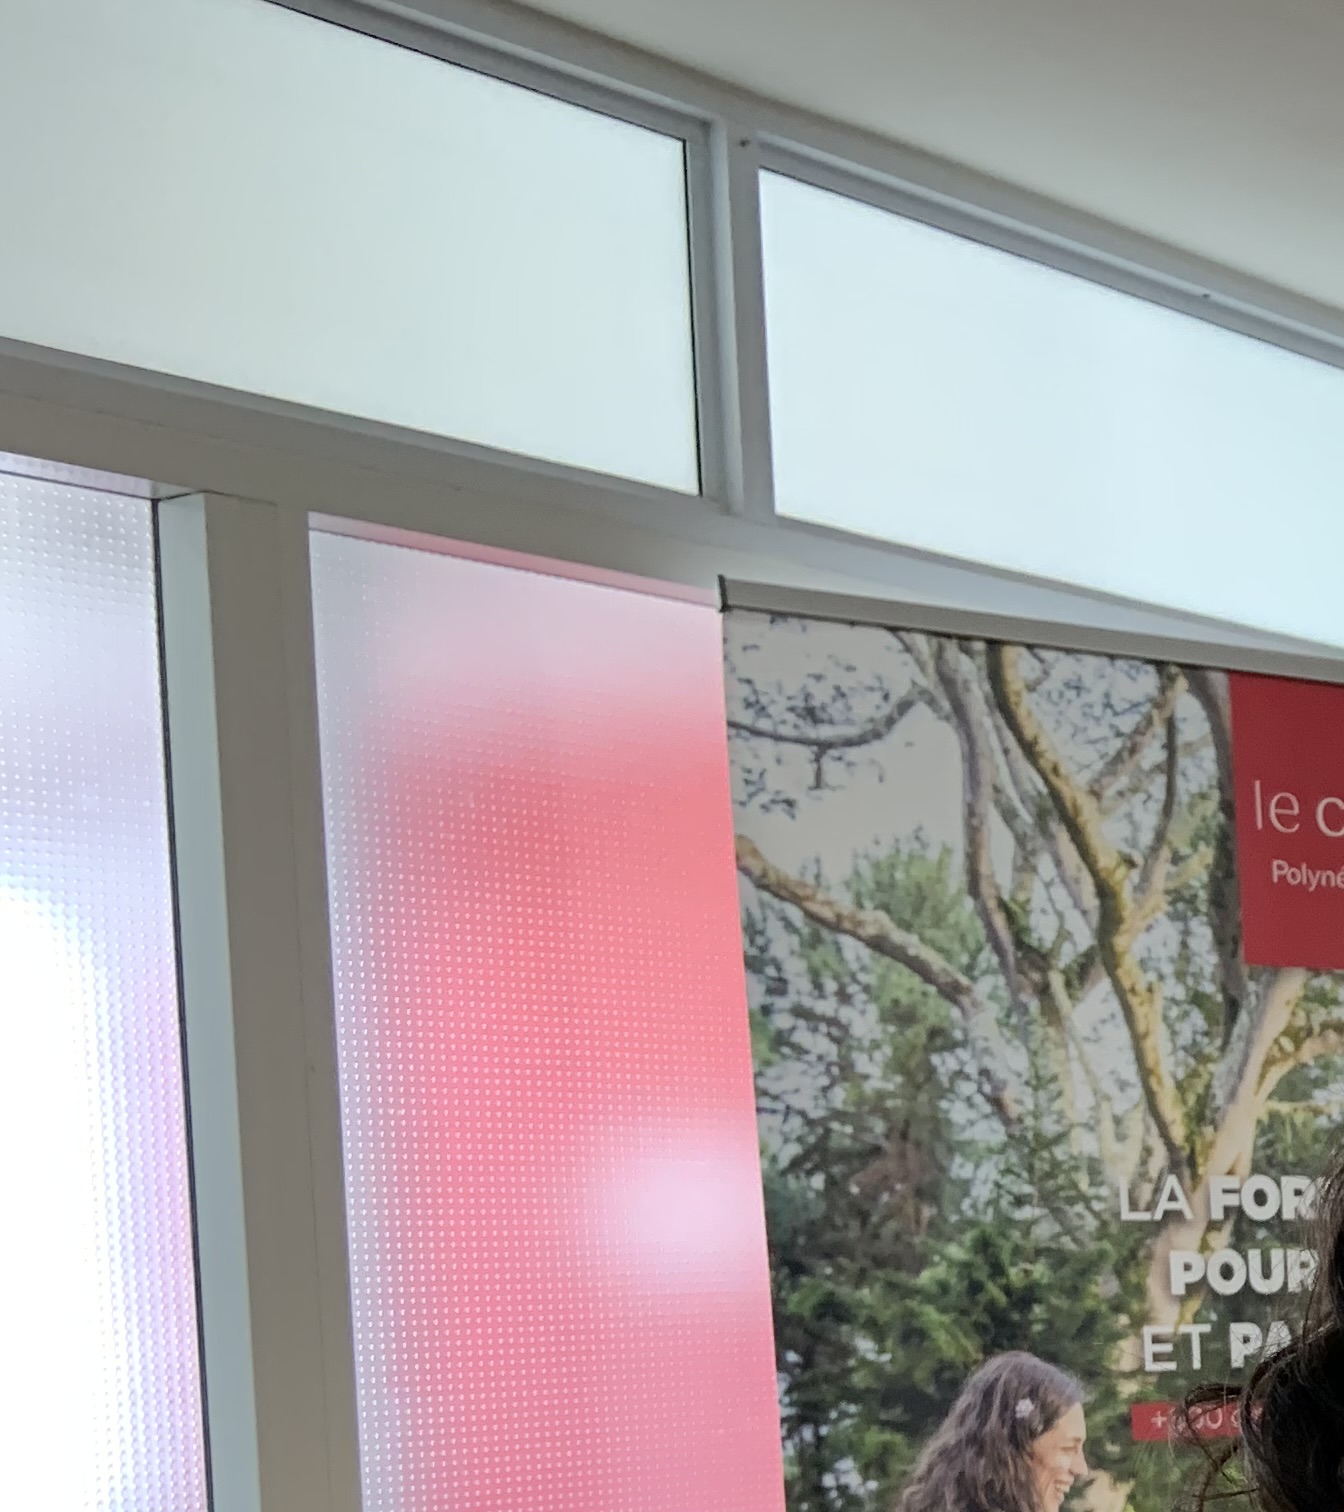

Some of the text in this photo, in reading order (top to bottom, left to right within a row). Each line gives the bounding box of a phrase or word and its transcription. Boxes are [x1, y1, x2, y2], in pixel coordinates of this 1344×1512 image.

[1254, 779, 1301, 834] le
[1118, 1174, 1195, 1222] LA
[1168, 1247, 1320, 1296] POUR
[1142, 1322, 1212, 1373] ET
